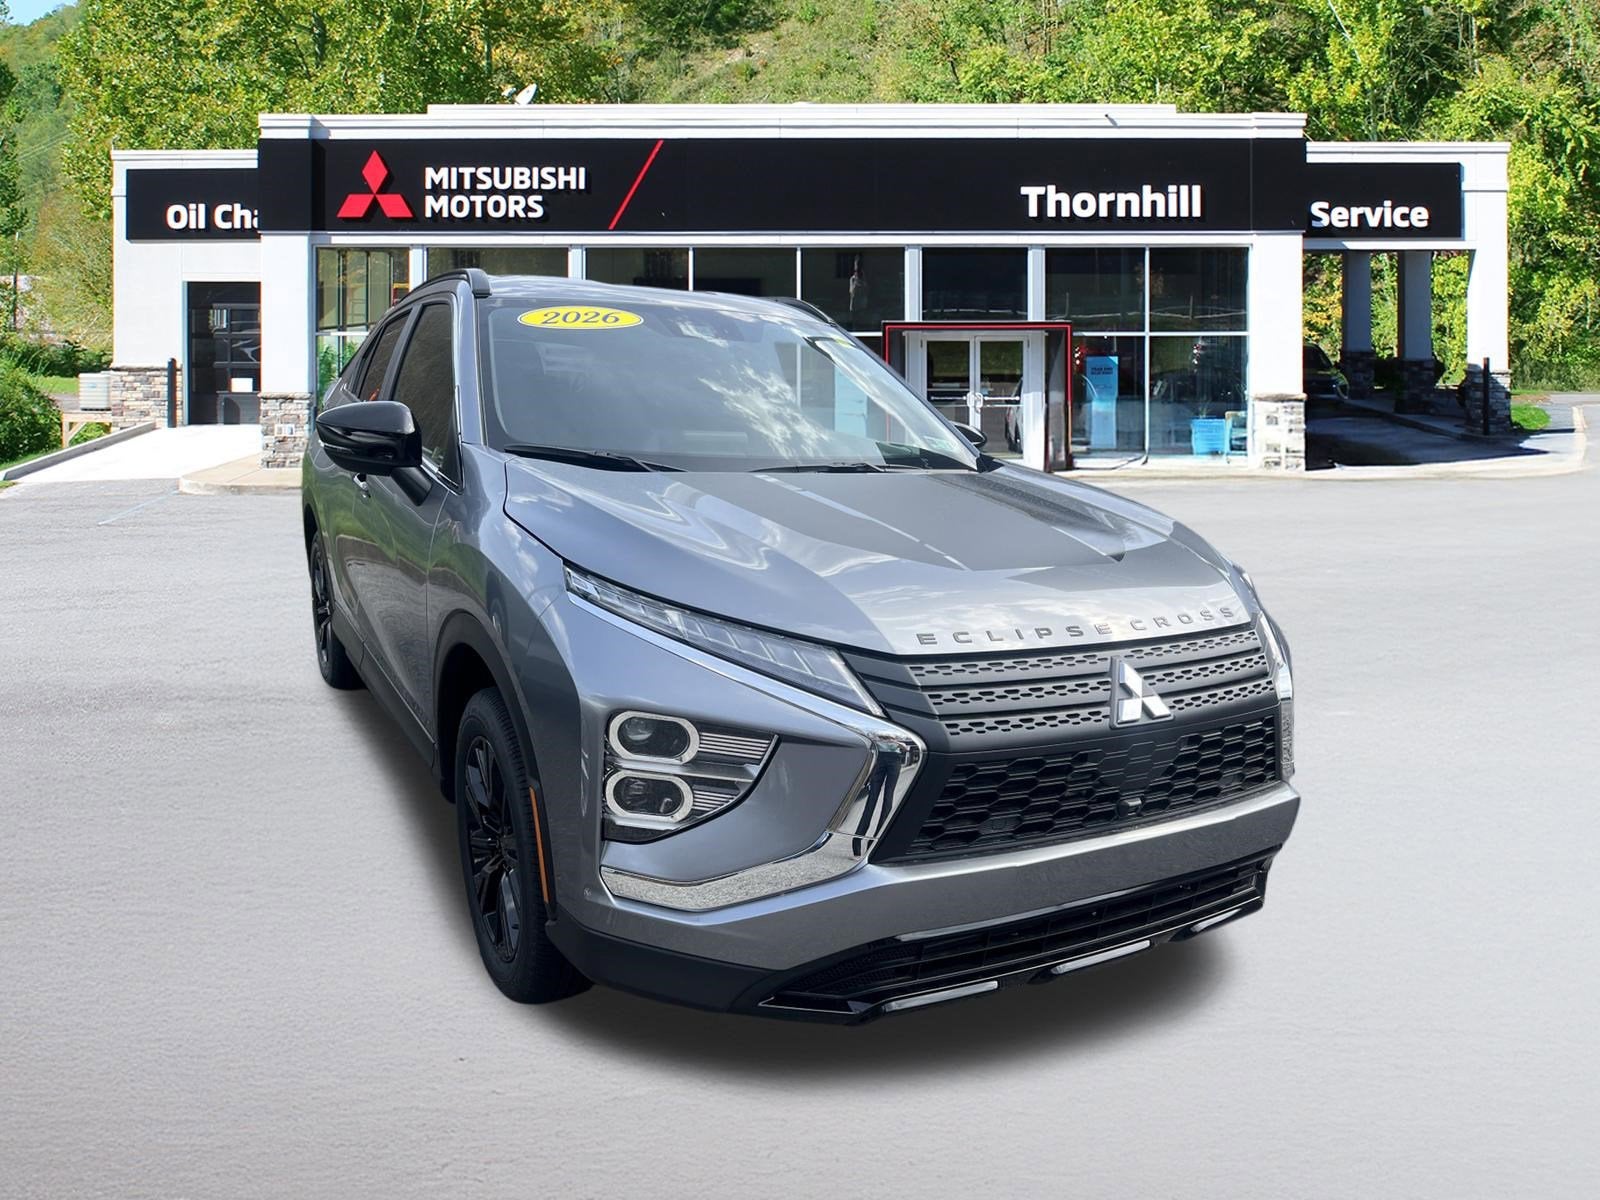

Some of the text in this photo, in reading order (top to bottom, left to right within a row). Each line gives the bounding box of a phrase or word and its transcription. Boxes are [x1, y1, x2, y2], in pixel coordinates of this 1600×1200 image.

[424, 166, 586, 191] MITSUBISHI
[424, 194, 545, 219] MOTORS
[1020, 184, 1202, 218] Thornhill
[1309, 199, 1430, 228] Service
[165, 202, 206, 230] Oil
[540, 310, 622, 325] 2026
[915, 606, 1235, 646] ECLIPSE CROSS
